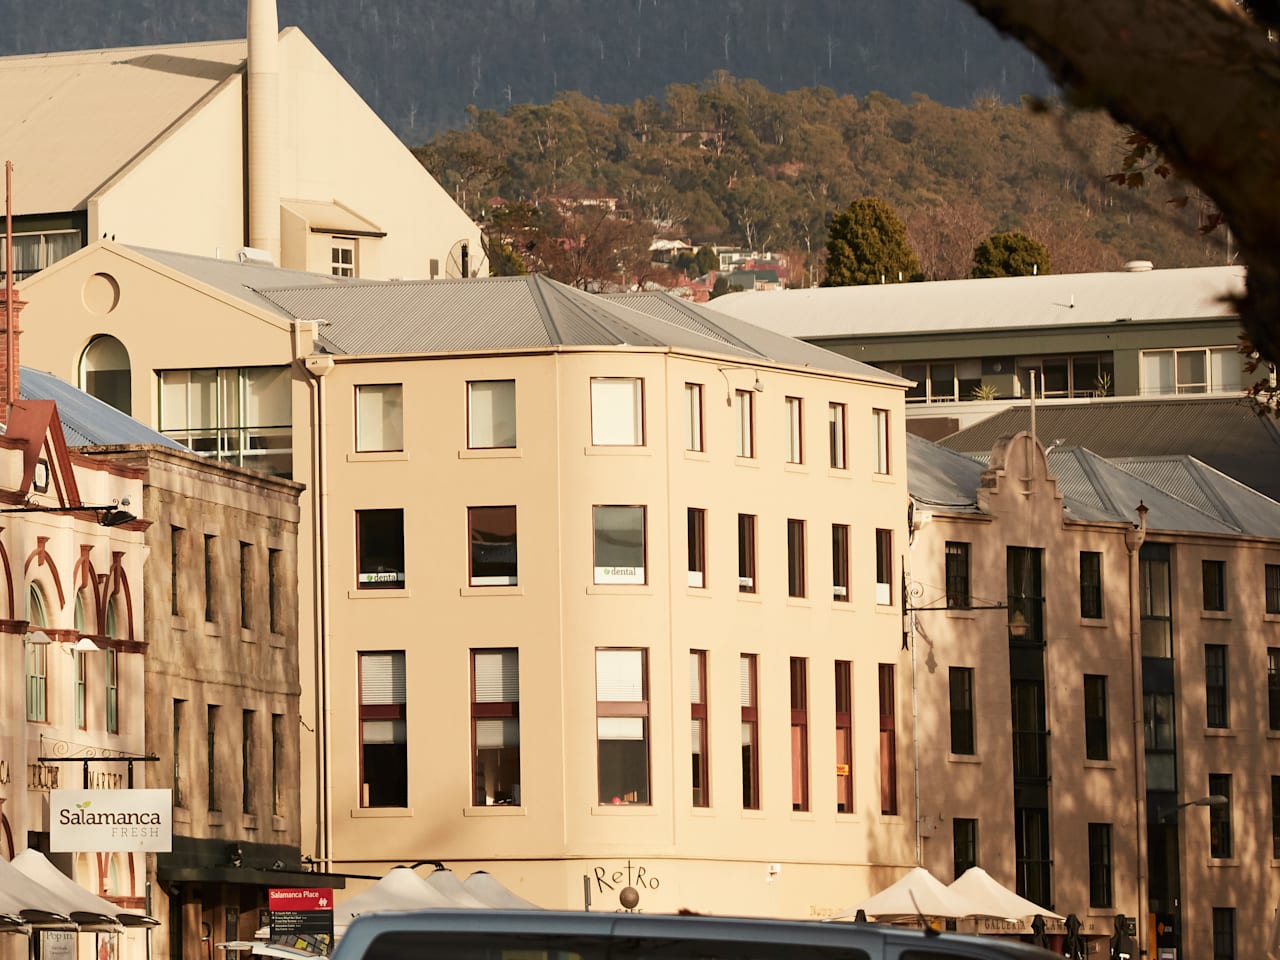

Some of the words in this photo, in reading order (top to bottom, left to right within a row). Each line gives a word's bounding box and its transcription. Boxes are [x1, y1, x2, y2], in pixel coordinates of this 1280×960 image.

[610, 567, 636, 576] dental
[59, 808, 162, 826] Salamanca
[111, 827, 160, 838] FRESH
[270, 891, 302, 899] Salamanca
